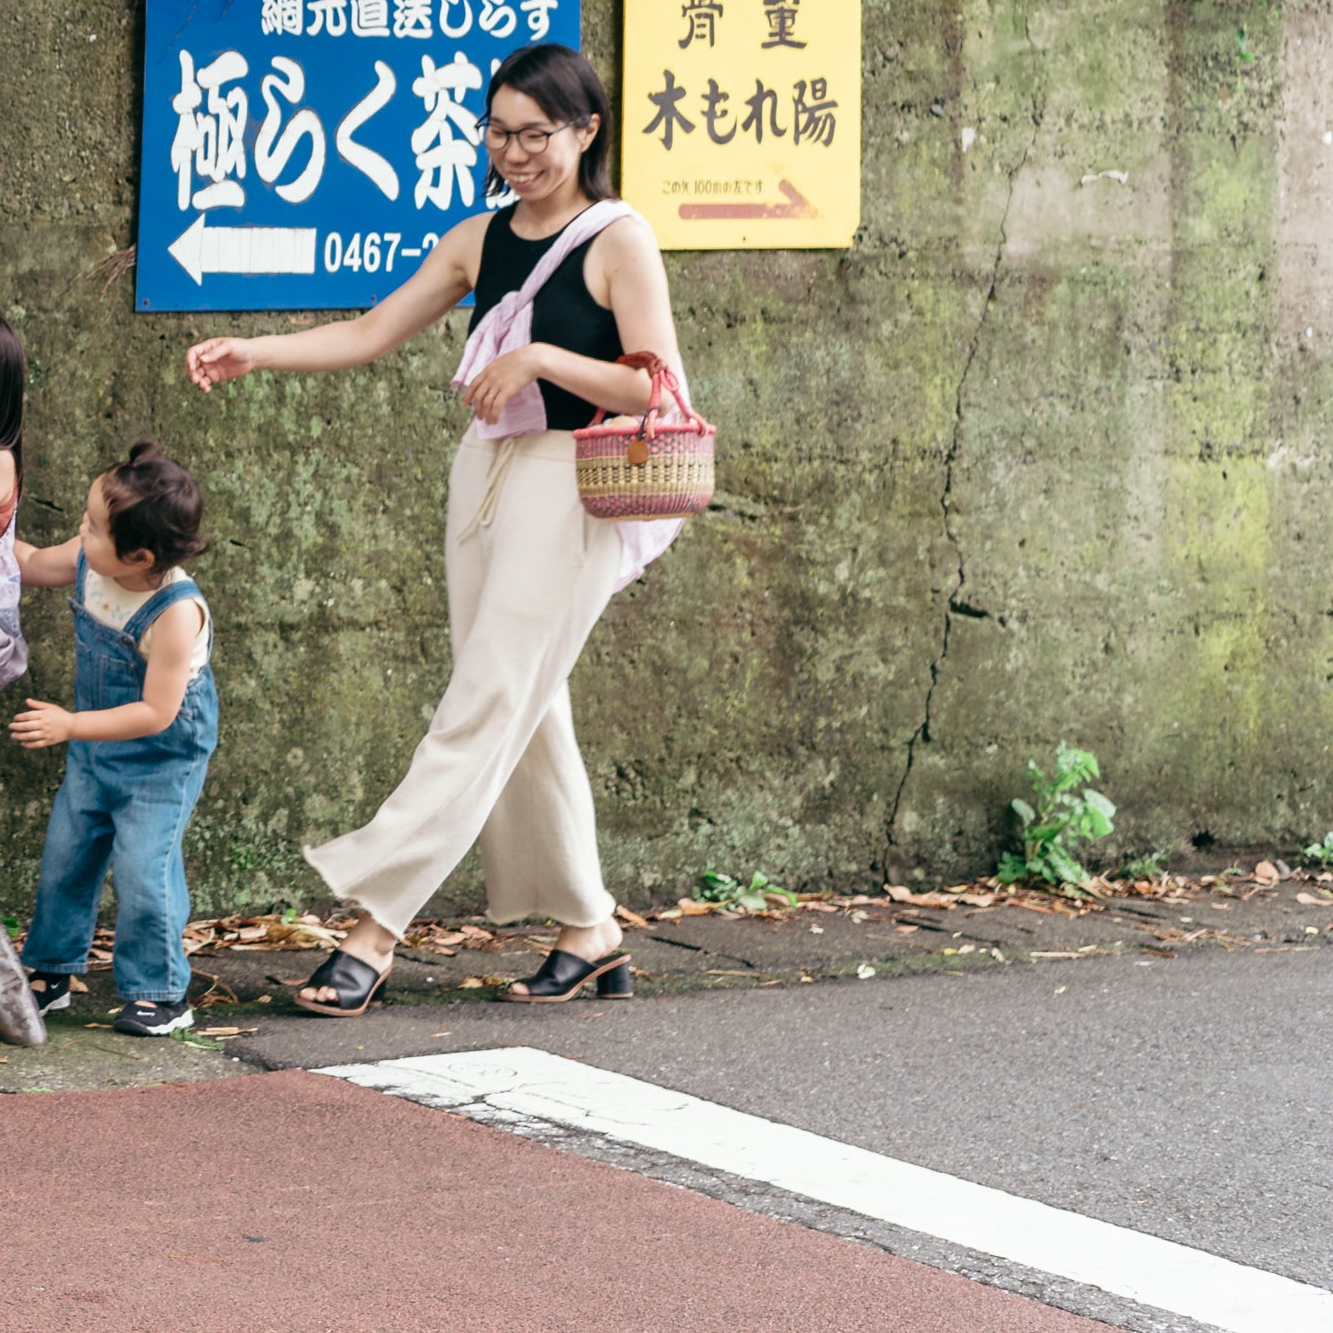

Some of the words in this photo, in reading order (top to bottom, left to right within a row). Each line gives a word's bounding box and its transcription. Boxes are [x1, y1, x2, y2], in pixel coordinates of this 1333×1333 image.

[171, 48, 523, 212] 極らく茶
[642, 69, 838, 151] 木もれ陽
